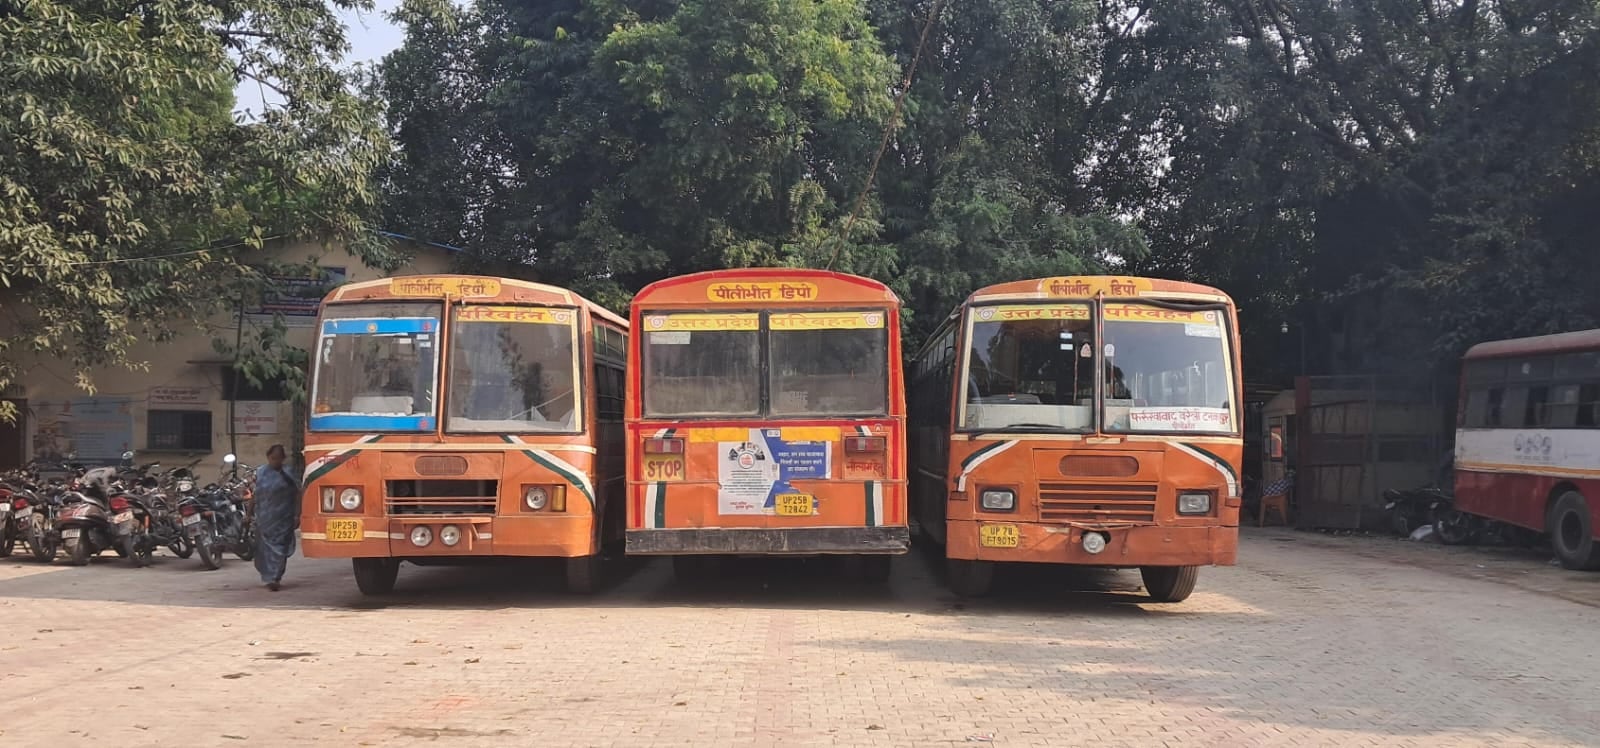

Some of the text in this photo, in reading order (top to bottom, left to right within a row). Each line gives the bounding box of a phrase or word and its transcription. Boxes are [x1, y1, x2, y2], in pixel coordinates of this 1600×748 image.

[713, 283, 812, 299] पीलीभीत डिपो
[1049, 280, 1136, 296] पीलीभीत डिपो
[456, 306, 545, 321] परिवहन
[1000, 307, 1044, 320] उत्तर
[1105, 304, 1193, 320] परिवहन
[669, 314, 859, 329] उत्तर प्रदेश परिवहन
[647, 460, 682, 478] STOP
[782, 496, 808, 504] UP25B
[783, 505, 808, 513] T2842
[332, 521, 358, 530] UP25B
[990, 527, 1001, 536] UP
[333, 531, 358, 539] T2927
